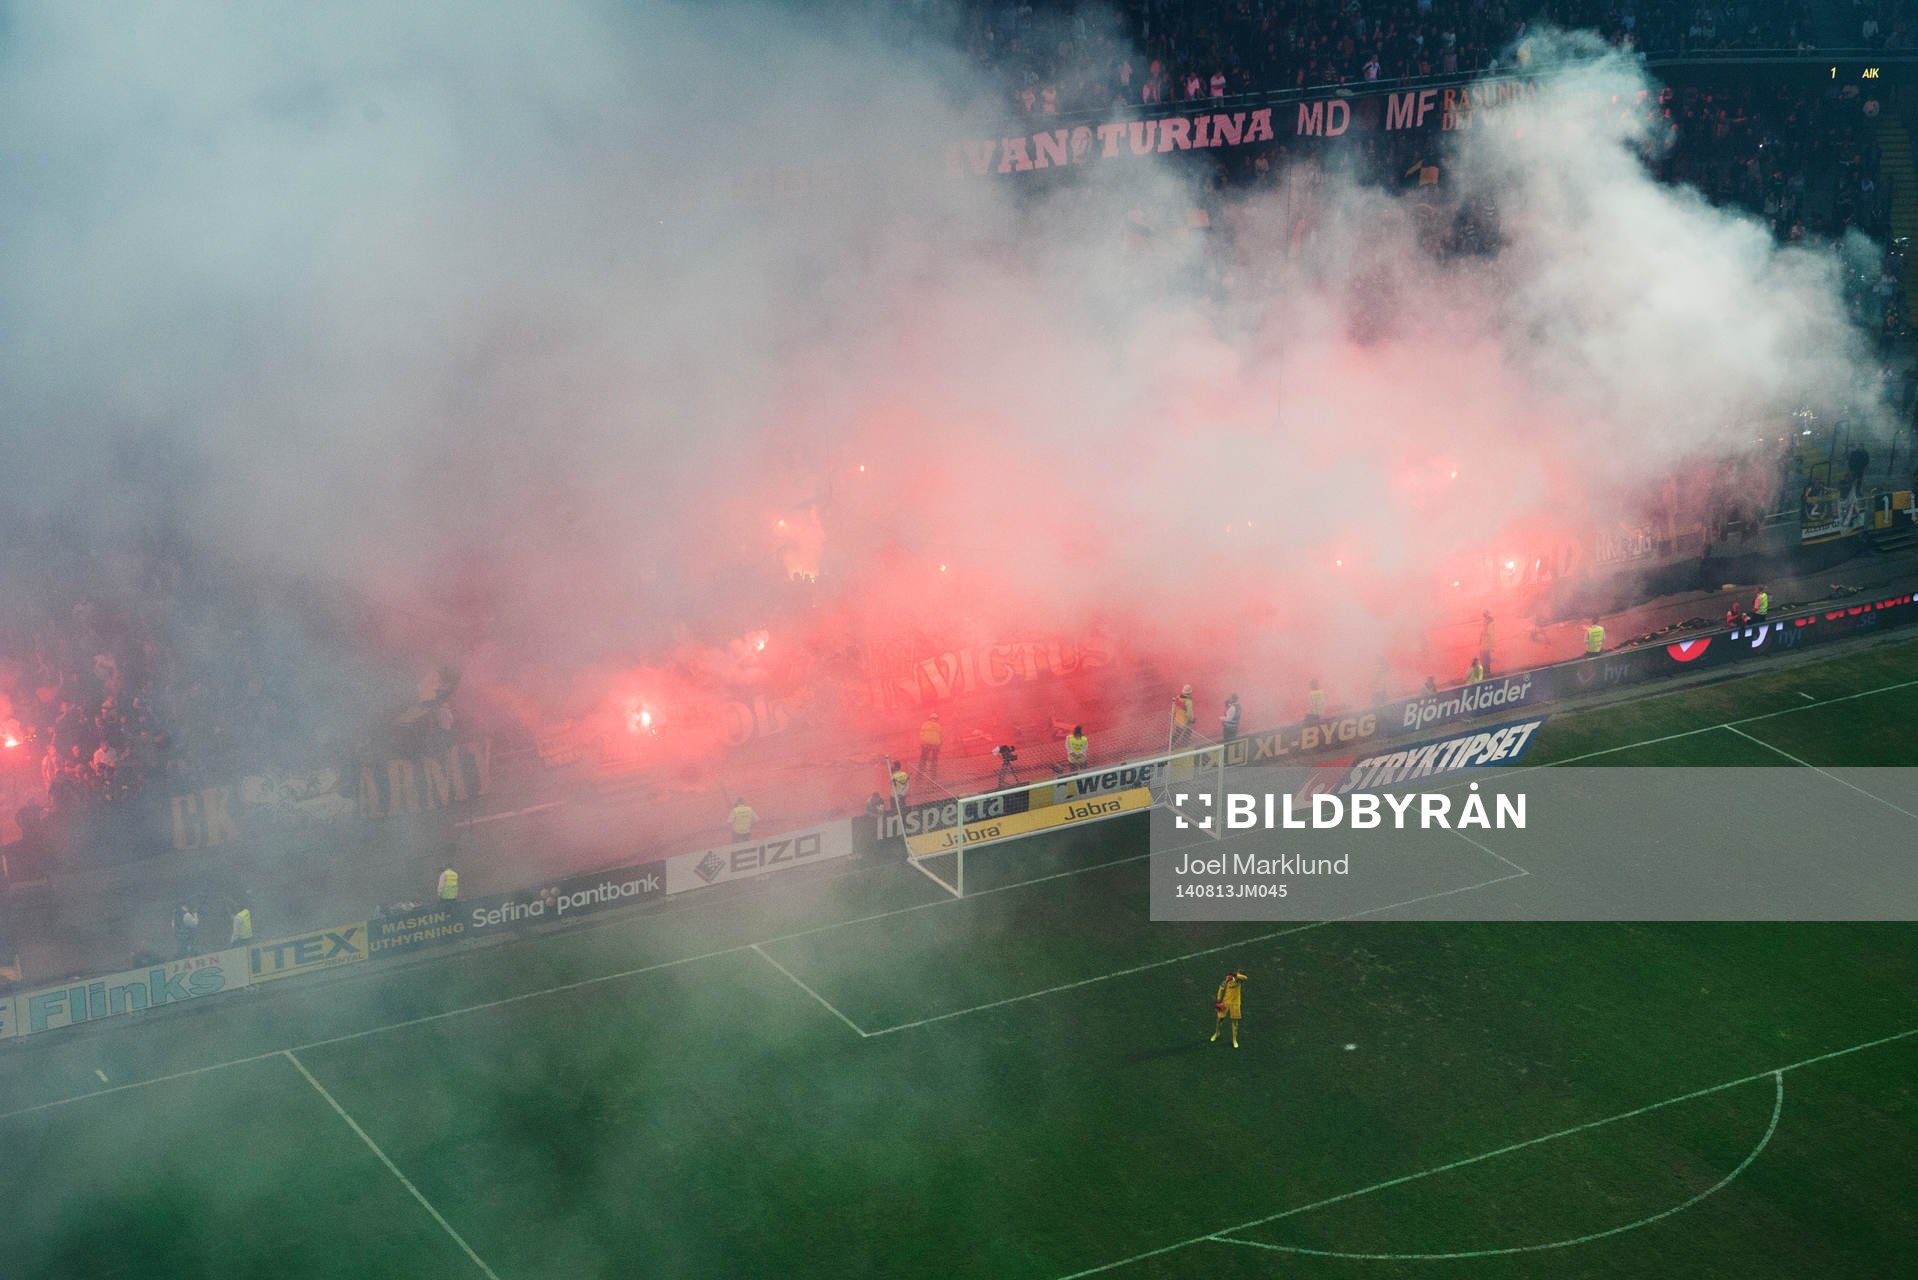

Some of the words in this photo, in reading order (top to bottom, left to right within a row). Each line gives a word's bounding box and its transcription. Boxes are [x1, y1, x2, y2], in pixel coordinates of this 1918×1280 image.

[1861, 67, 1880, 79] AIK
[1097, 108, 1274, 158] TURINA
[1297, 100, 1351, 136] MD
[1385, 89, 1437, 131] MF
[1403, 677, 1533, 729] Björnkläder
[1254, 713, 1378, 762] XL-BYGG
[1338, 720, 1543, 795] STRYKTIPSET
[1064, 798, 1121, 821] Jabra
[730, 833, 822, 873] EIZO
[941, 824, 1001, 849] Jabra
[381, 911, 451, 935] MASKIN-
[472, 899, 545, 928] Sefina
[557, 873, 660, 915] pantbank
[251, 927, 359, 974] ITEX
[369, 922, 465, 953] UTHYRNING
[28, 967, 226, 1034] Flinks
